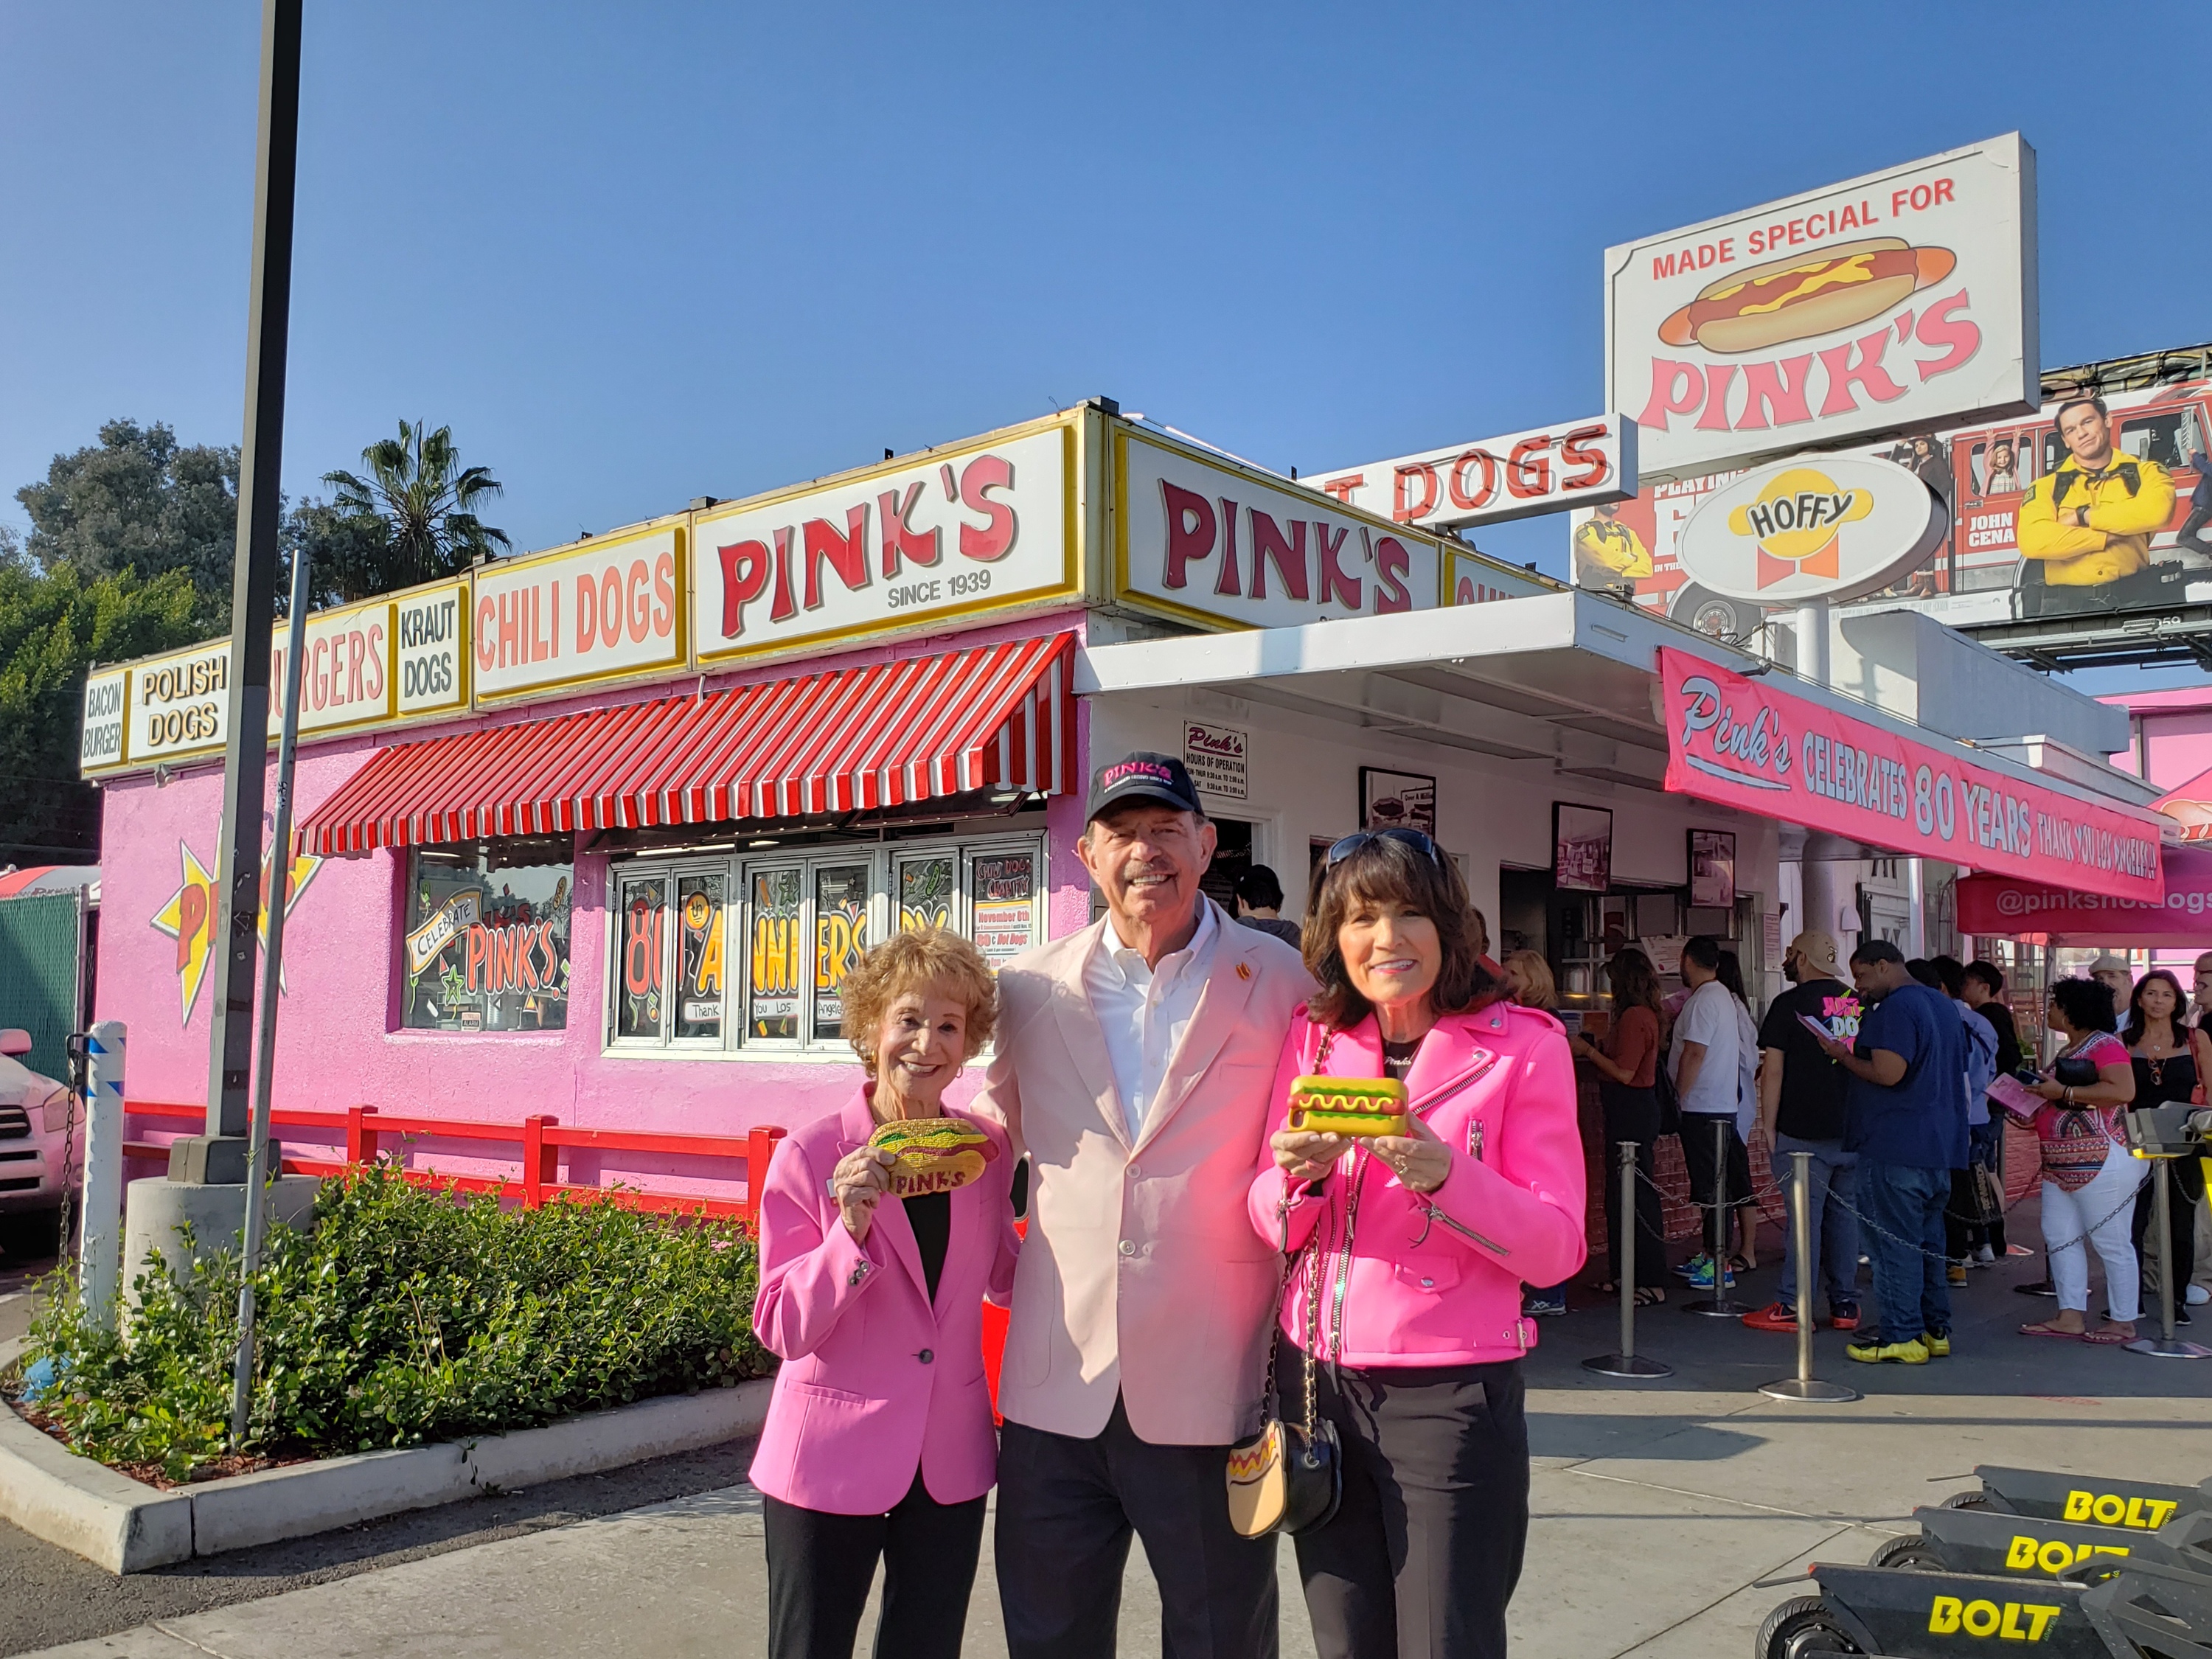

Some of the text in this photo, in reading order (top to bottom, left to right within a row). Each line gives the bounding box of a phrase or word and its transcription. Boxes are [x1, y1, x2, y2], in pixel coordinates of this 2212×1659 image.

[1652, 178, 1955, 280] MADE SPECIAL FOR
[1638, 287, 1983, 432] PINK'S
[1393, 423, 1607, 523] DOGS
[1654, 469, 1745, 498] PLAYIN
[1750, 493, 1852, 539] HOFFY
[1969, 512, 2014, 532] JOHN
[717, 454, 1018, 639] PINK'S
[1158, 477, 1412, 616] PINK'S
[1968, 527, 2015, 547] CENA
[1654, 562, 1680, 573] IN THE
[888, 569, 992, 608] SINCE 1939
[400, 599, 456, 649] KRAUT
[476, 552, 674, 672] CHILI DOGS
[142, 655, 226, 706] POLISH
[268, 624, 383, 719] URGERS
[404, 652, 452, 698] DOGS
[88, 681, 121, 718] BACON
[83, 721, 122, 758] BURGER
[147, 701, 218, 746] DOGS
[1188, 726, 1244, 754] Pink's
[1104, 762, 1172, 787] PINK'S
[1186, 753, 1245, 774] HOURS OF OPERATION
[1680, 675, 1792, 773] Pink's
[1801, 730, 1908, 820] CELEBRATES
[1914, 765, 1955, 842] 80
[1960, 779, 2032, 860] YEARS
[2037, 813, 2074, 861] THANK
[2074, 823, 2095, 867] YOU
[2096, 828, 2112, 872] LOS
[978, 911, 1016, 923] November
[1997, 889, 2212, 914] @pinkshoog
[417, 902, 470, 956] CELEBRATE
[627, 894, 684, 998] 80
[997, 933, 1009, 945] Hot
[1009, 933, 1028, 946] Dogs
[466, 917, 558, 996] PINK'S
[693, 1001, 841, 1018] Thank You Los Angele
[1823, 997, 1860, 1017] JUST
[1832, 1016, 1859, 1037] DO
[896, 1170, 966, 1194] PINK'S
[2063, 1489, 2178, 1529] BOLT
[1927, 1595, 2061, 1642] BOLT
